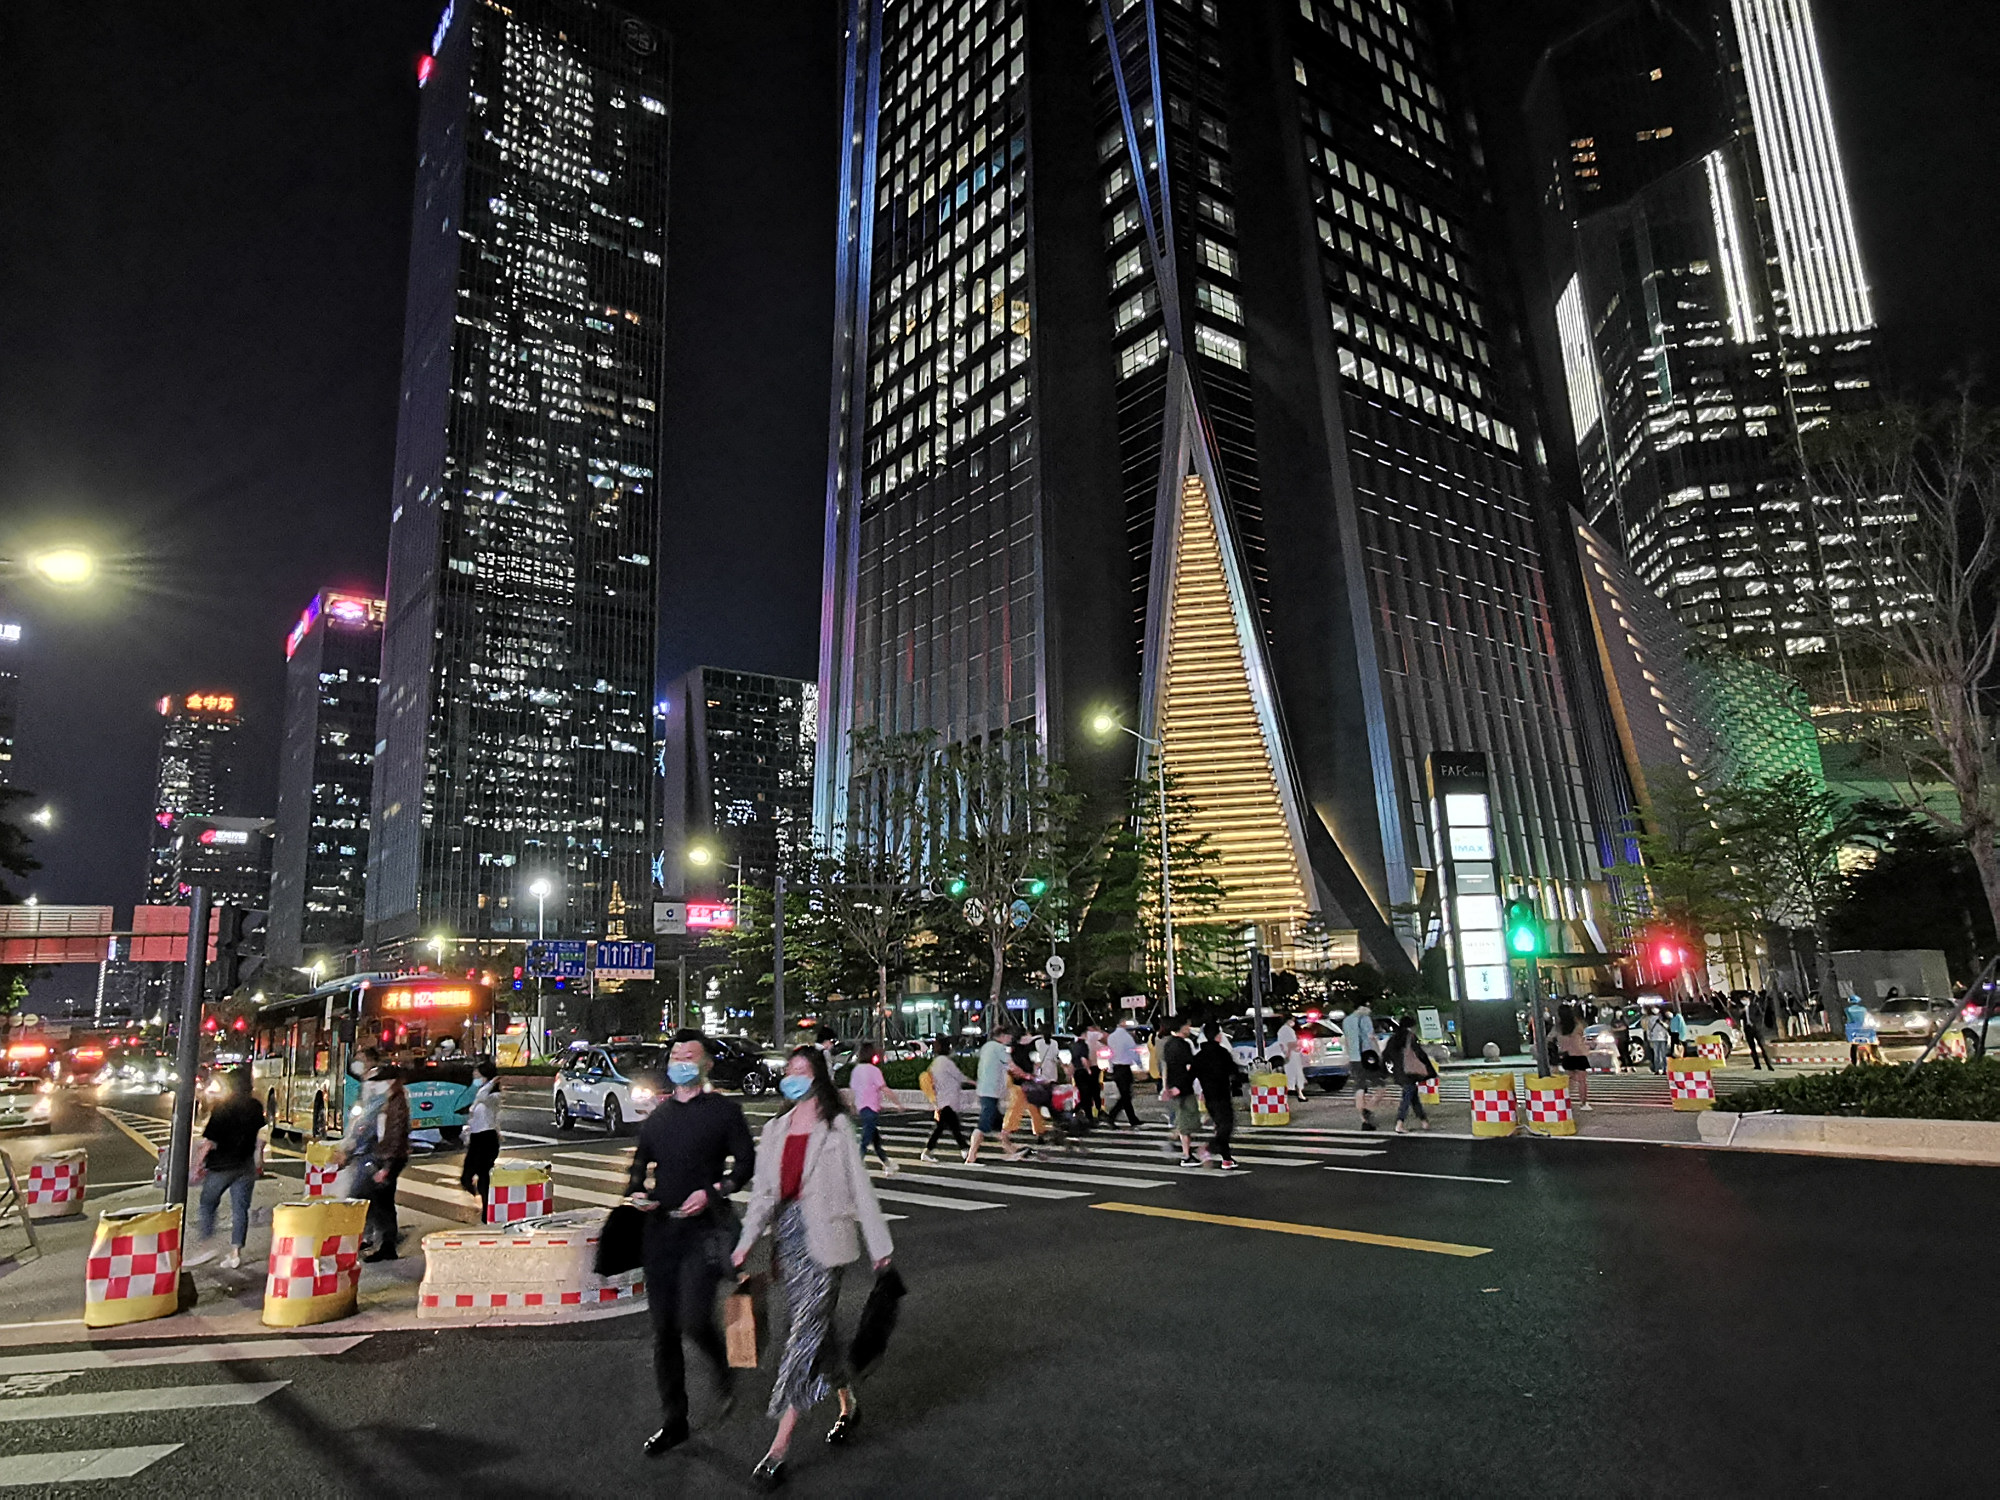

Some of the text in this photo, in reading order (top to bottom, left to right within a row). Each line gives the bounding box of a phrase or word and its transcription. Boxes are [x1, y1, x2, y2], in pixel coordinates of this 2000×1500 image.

[186, 693, 234, 711] 金中环
[1454, 844, 1484, 853] IMAX
